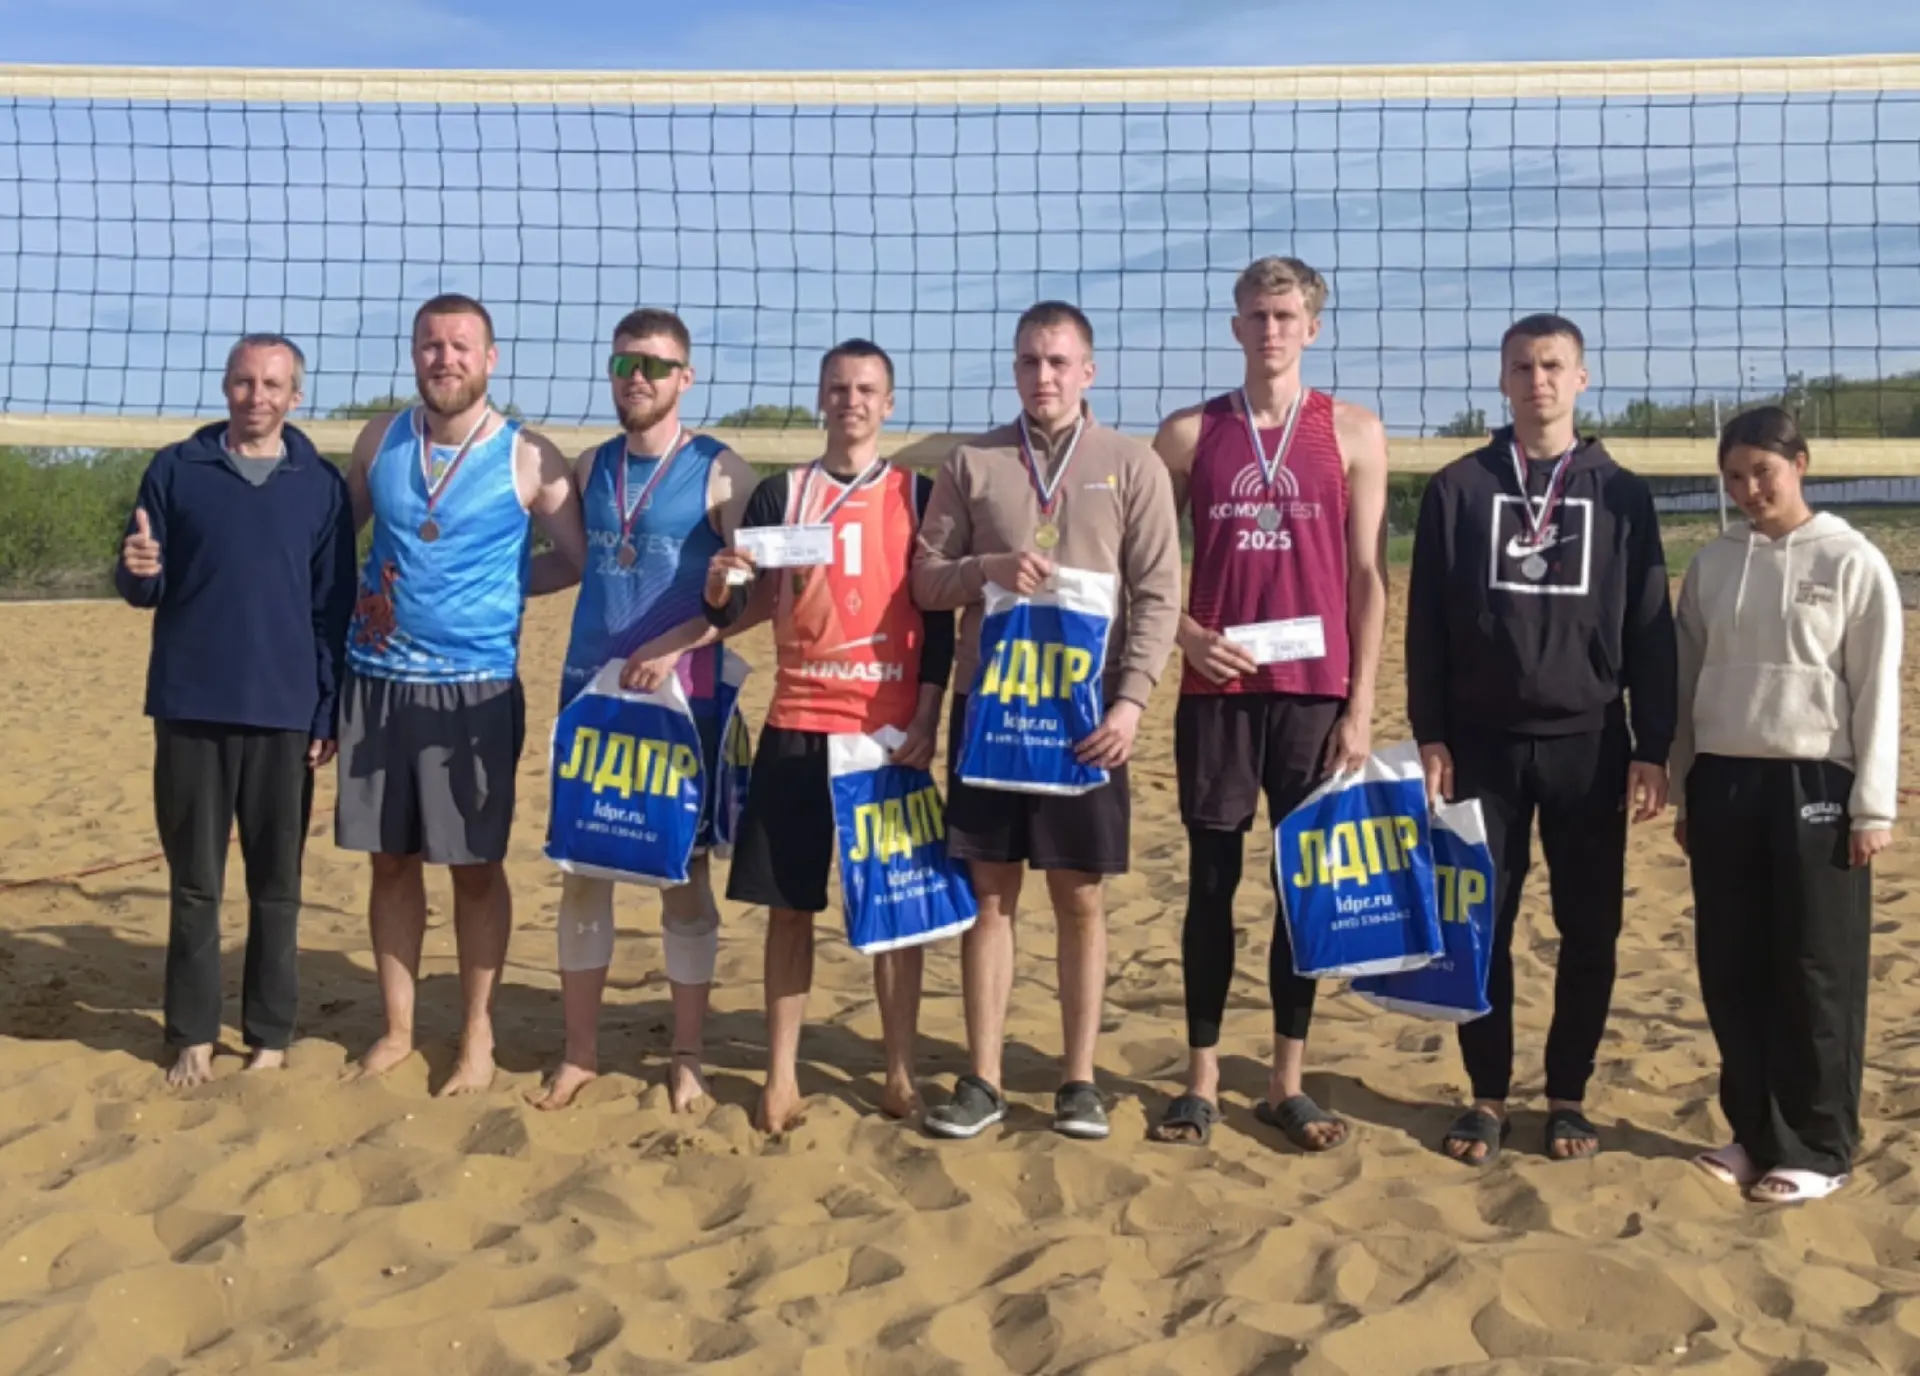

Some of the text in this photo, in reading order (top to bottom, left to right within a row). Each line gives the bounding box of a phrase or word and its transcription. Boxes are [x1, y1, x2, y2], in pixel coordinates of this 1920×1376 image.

[838, 522, 862, 577] 1
[1236, 529, 1292, 551] 2025
[558, 726, 698, 800] ЛДПР
[1292, 815, 1419, 891] ЛДПР
